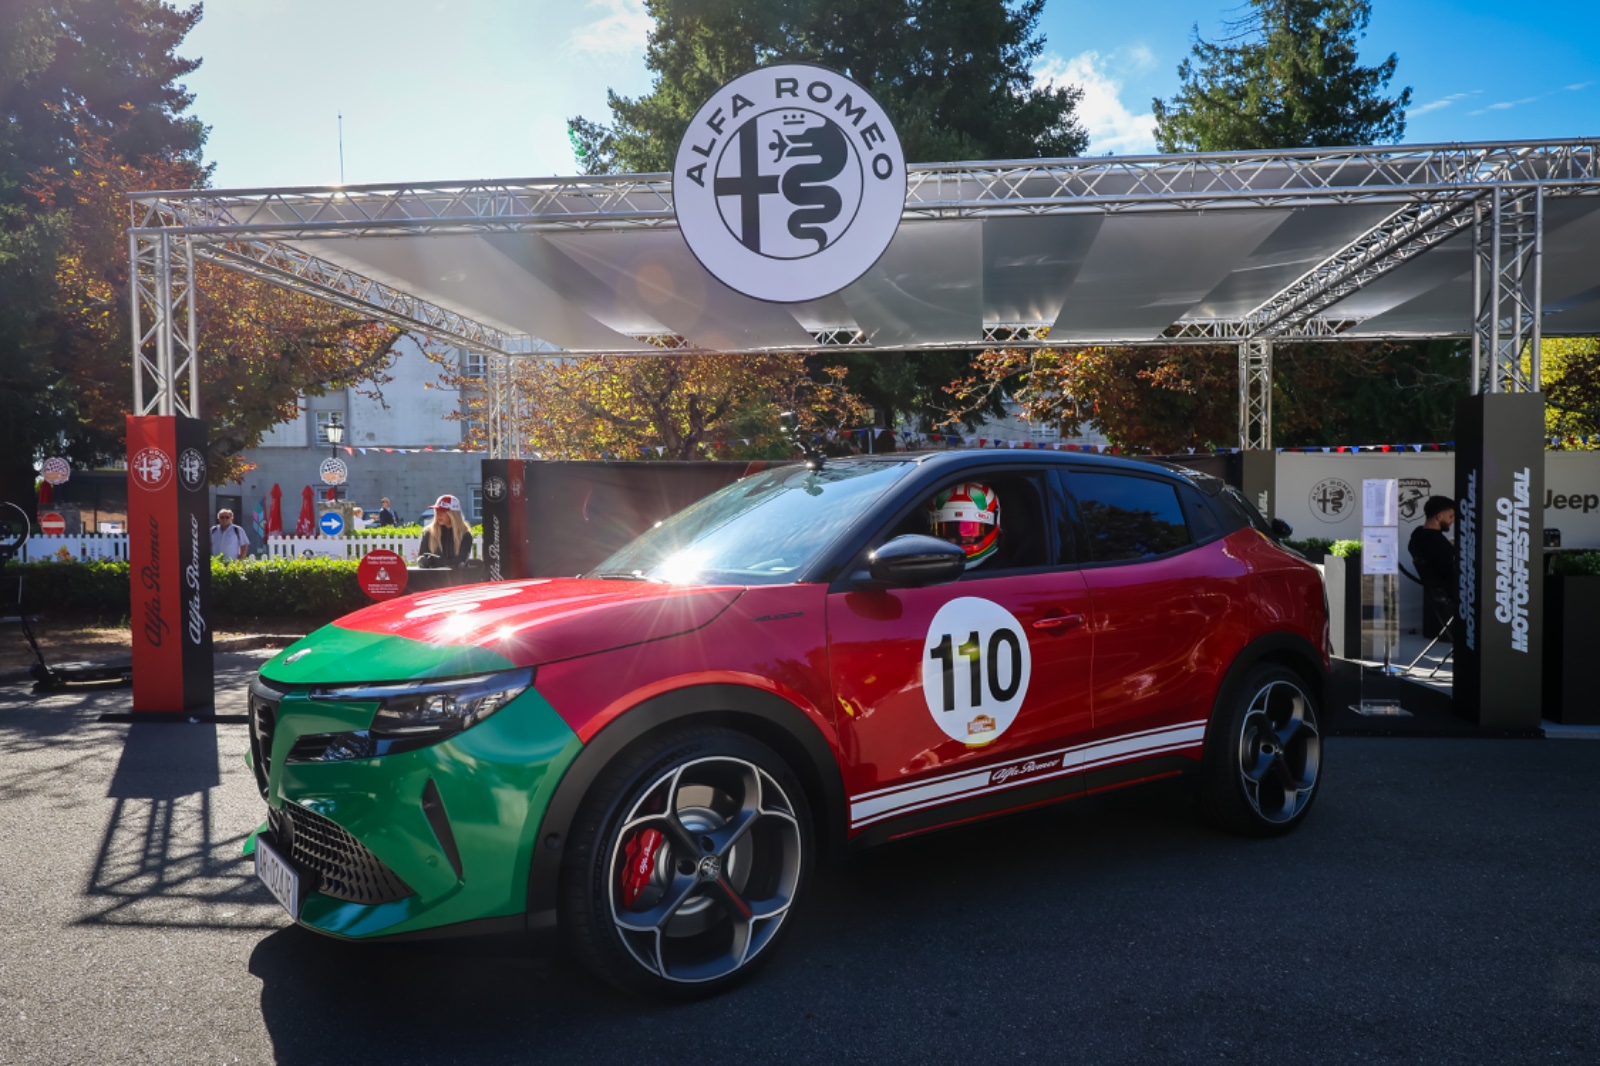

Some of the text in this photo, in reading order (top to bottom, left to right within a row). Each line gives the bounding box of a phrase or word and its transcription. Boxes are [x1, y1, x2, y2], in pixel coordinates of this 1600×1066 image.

[686, 78, 893, 188] ALFA ROMEO
[489, 514, 500, 560] Romeo
[1459, 498, 1468, 621] CARAMULO
[1465, 468, 1477, 651] MOTORFESTIVAL
[1495, 497, 1513, 623] CARAMULO
[1511, 467, 1530, 653] MOTORFESTIVAL
[1543, 489, 1599, 513] Jeep
[142, 513, 170, 647] Alfa Romeo
[186, 513, 206, 645] Alfa Romeo
[930, 628, 1022, 712] 110
